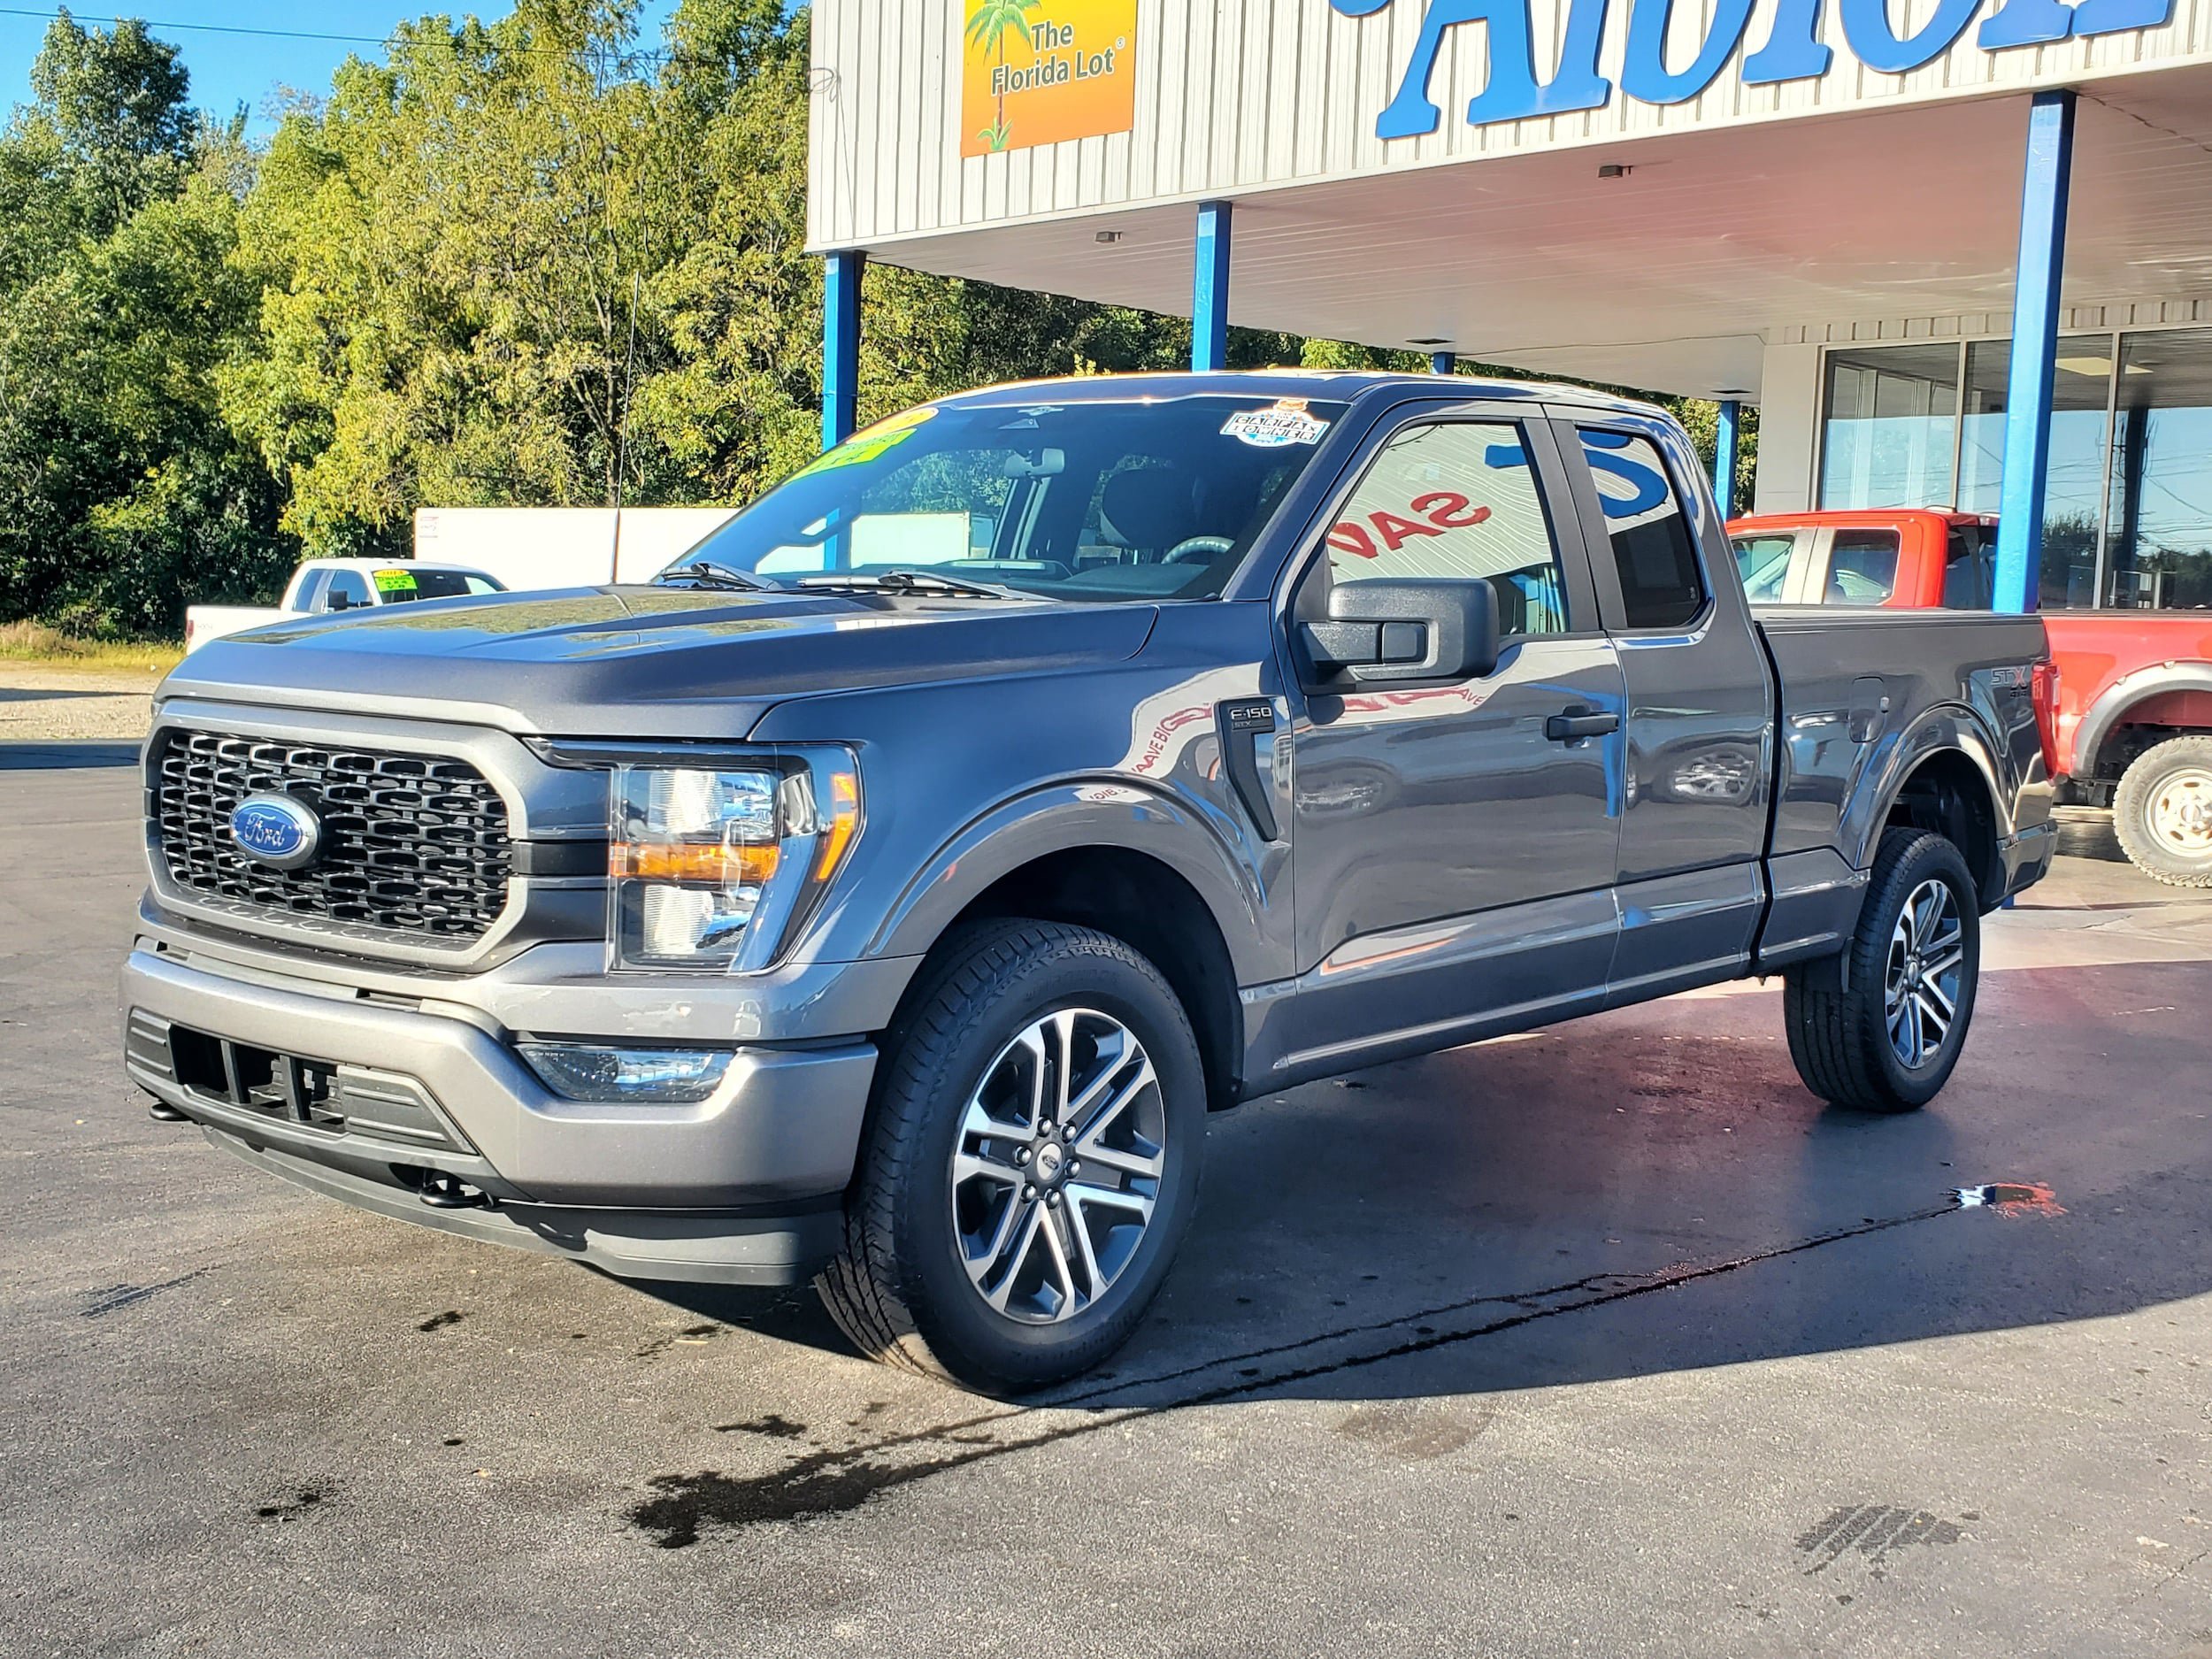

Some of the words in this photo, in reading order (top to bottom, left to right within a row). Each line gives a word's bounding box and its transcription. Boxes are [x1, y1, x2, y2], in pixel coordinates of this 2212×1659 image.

[1031, 19, 1073, 51] The
[991, 57, 1070, 95] Florida
[1076, 48, 1114, 79] Lot
[1235, 416, 1317, 432] CARFAX
[1241, 425, 1317, 441] OWNER
[1991, 665, 2027, 688] STX
[1230, 707, 1273, 720] F-150
[244, 811, 286, 848] Ford
